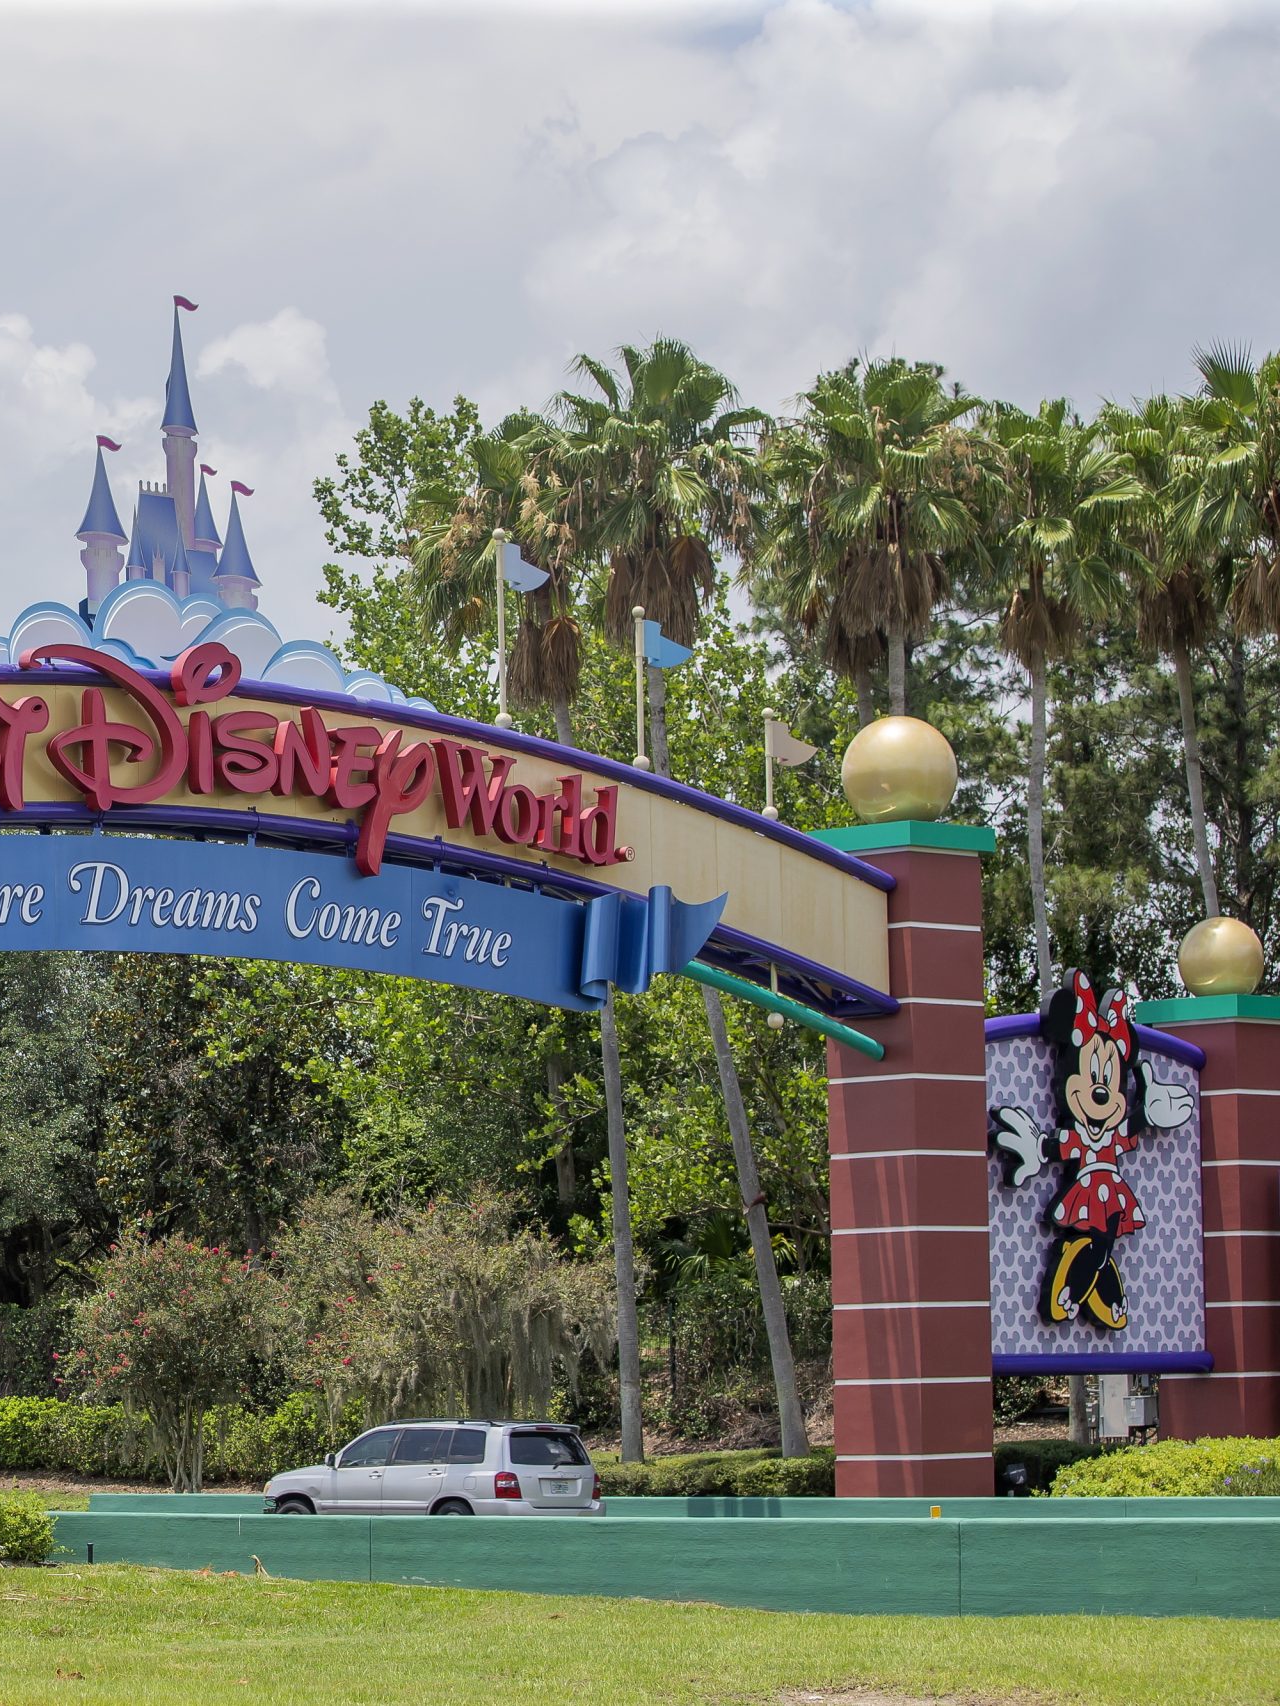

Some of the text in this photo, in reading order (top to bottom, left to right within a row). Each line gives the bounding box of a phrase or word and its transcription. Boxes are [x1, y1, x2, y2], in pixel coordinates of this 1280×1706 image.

[67, 860, 262, 933] Dreams
[285, 875, 402, 949] Come
[422, 896, 513, 968] True
